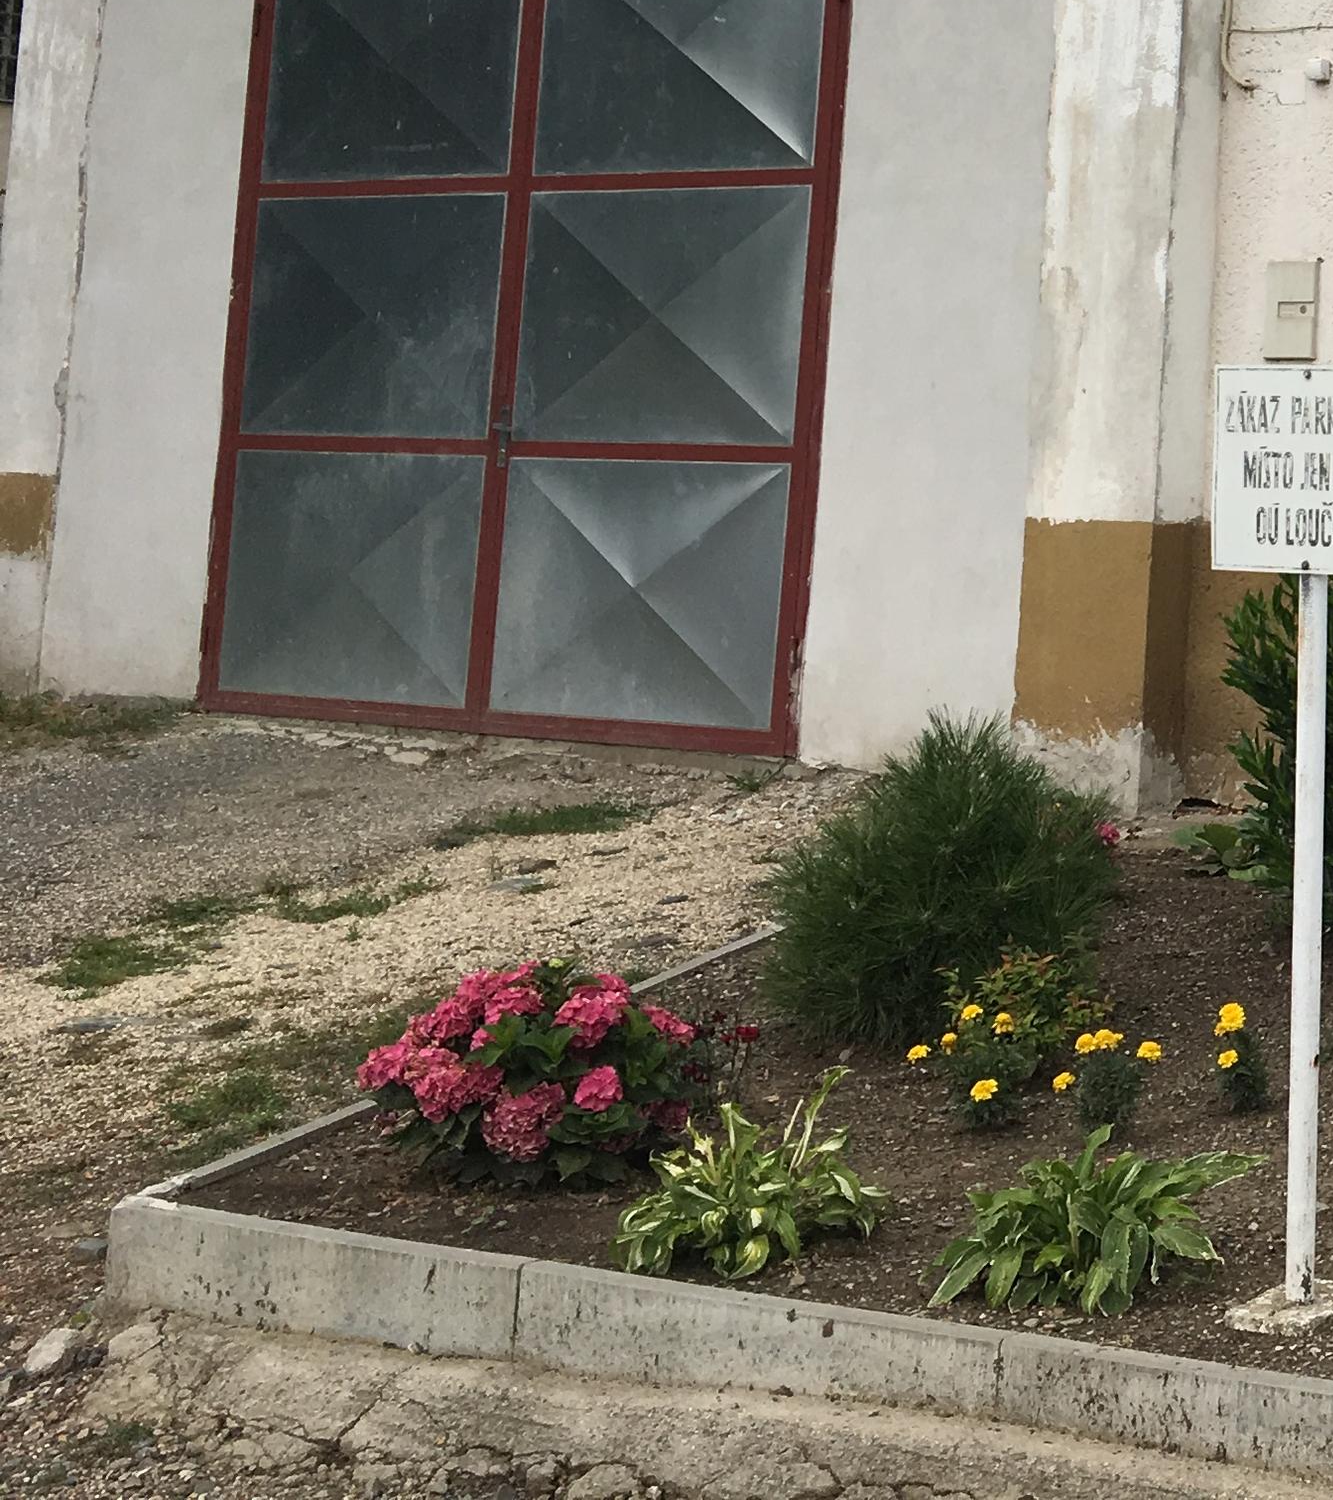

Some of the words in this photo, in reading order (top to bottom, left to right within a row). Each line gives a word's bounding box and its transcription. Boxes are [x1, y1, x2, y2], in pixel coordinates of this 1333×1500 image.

[1225, 390, 1281, 434] ZÁKAZ
[1243, 446, 1294, 489] MÍSTO
[1300, 452, 1331, 491] JEN
[1256, 502, 1280, 545] OÚ
